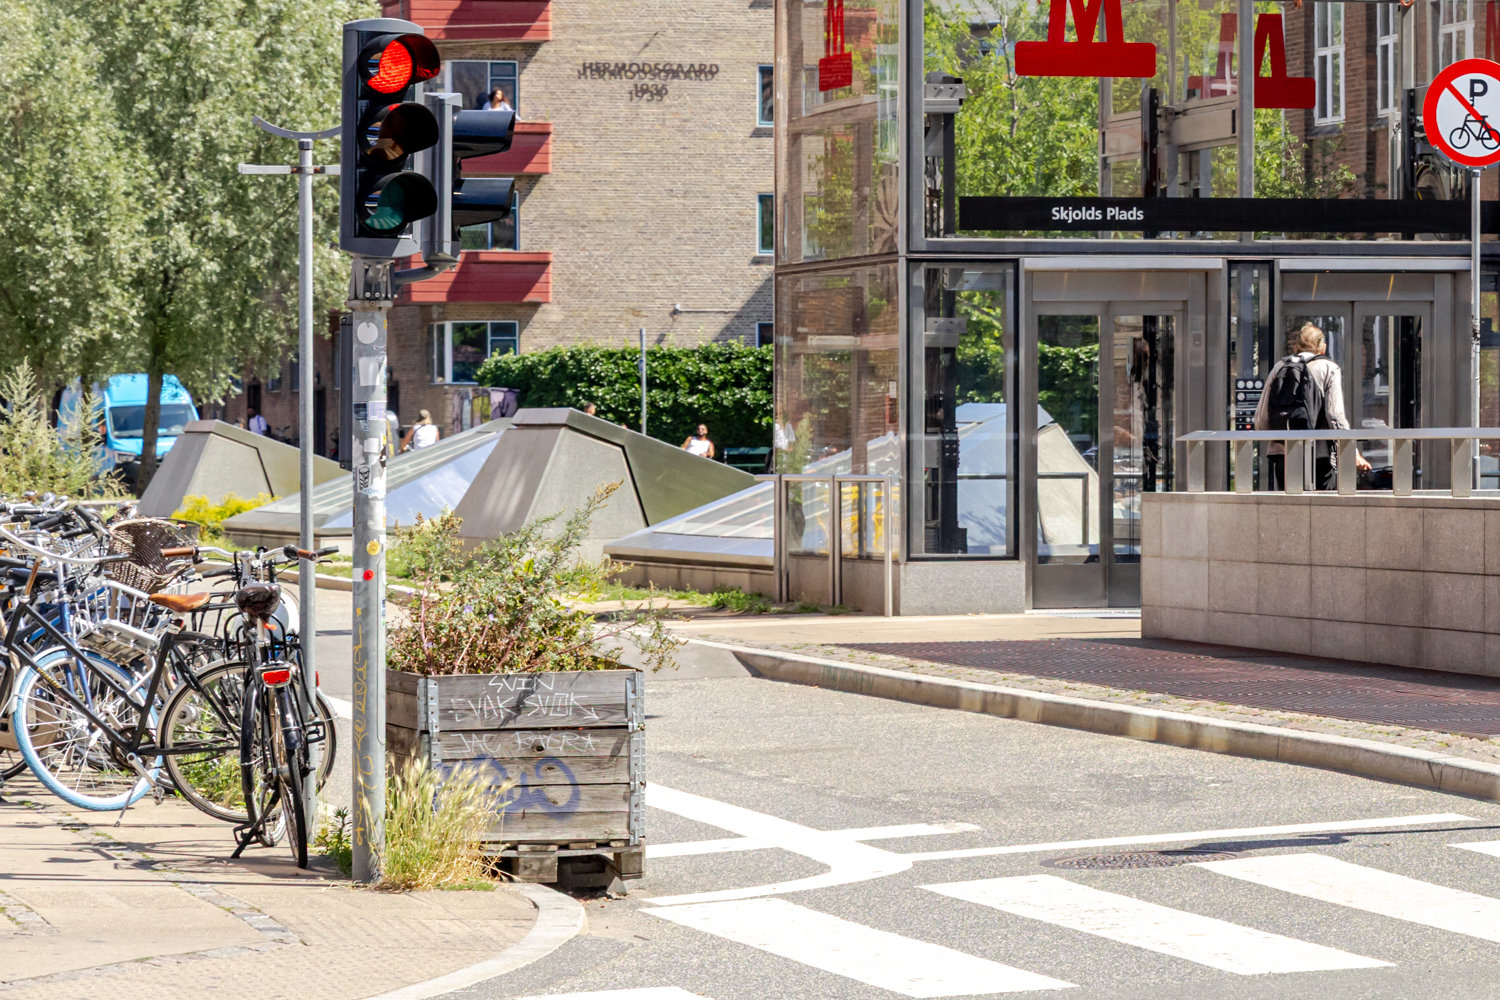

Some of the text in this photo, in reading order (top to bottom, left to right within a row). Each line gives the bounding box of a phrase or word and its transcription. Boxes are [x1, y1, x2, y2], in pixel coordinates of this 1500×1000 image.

[1470, 79, 1488, 98] P
[1051, 206, 1144, 223] Skjolds Plads
[489, 675, 555, 693] SVIN
